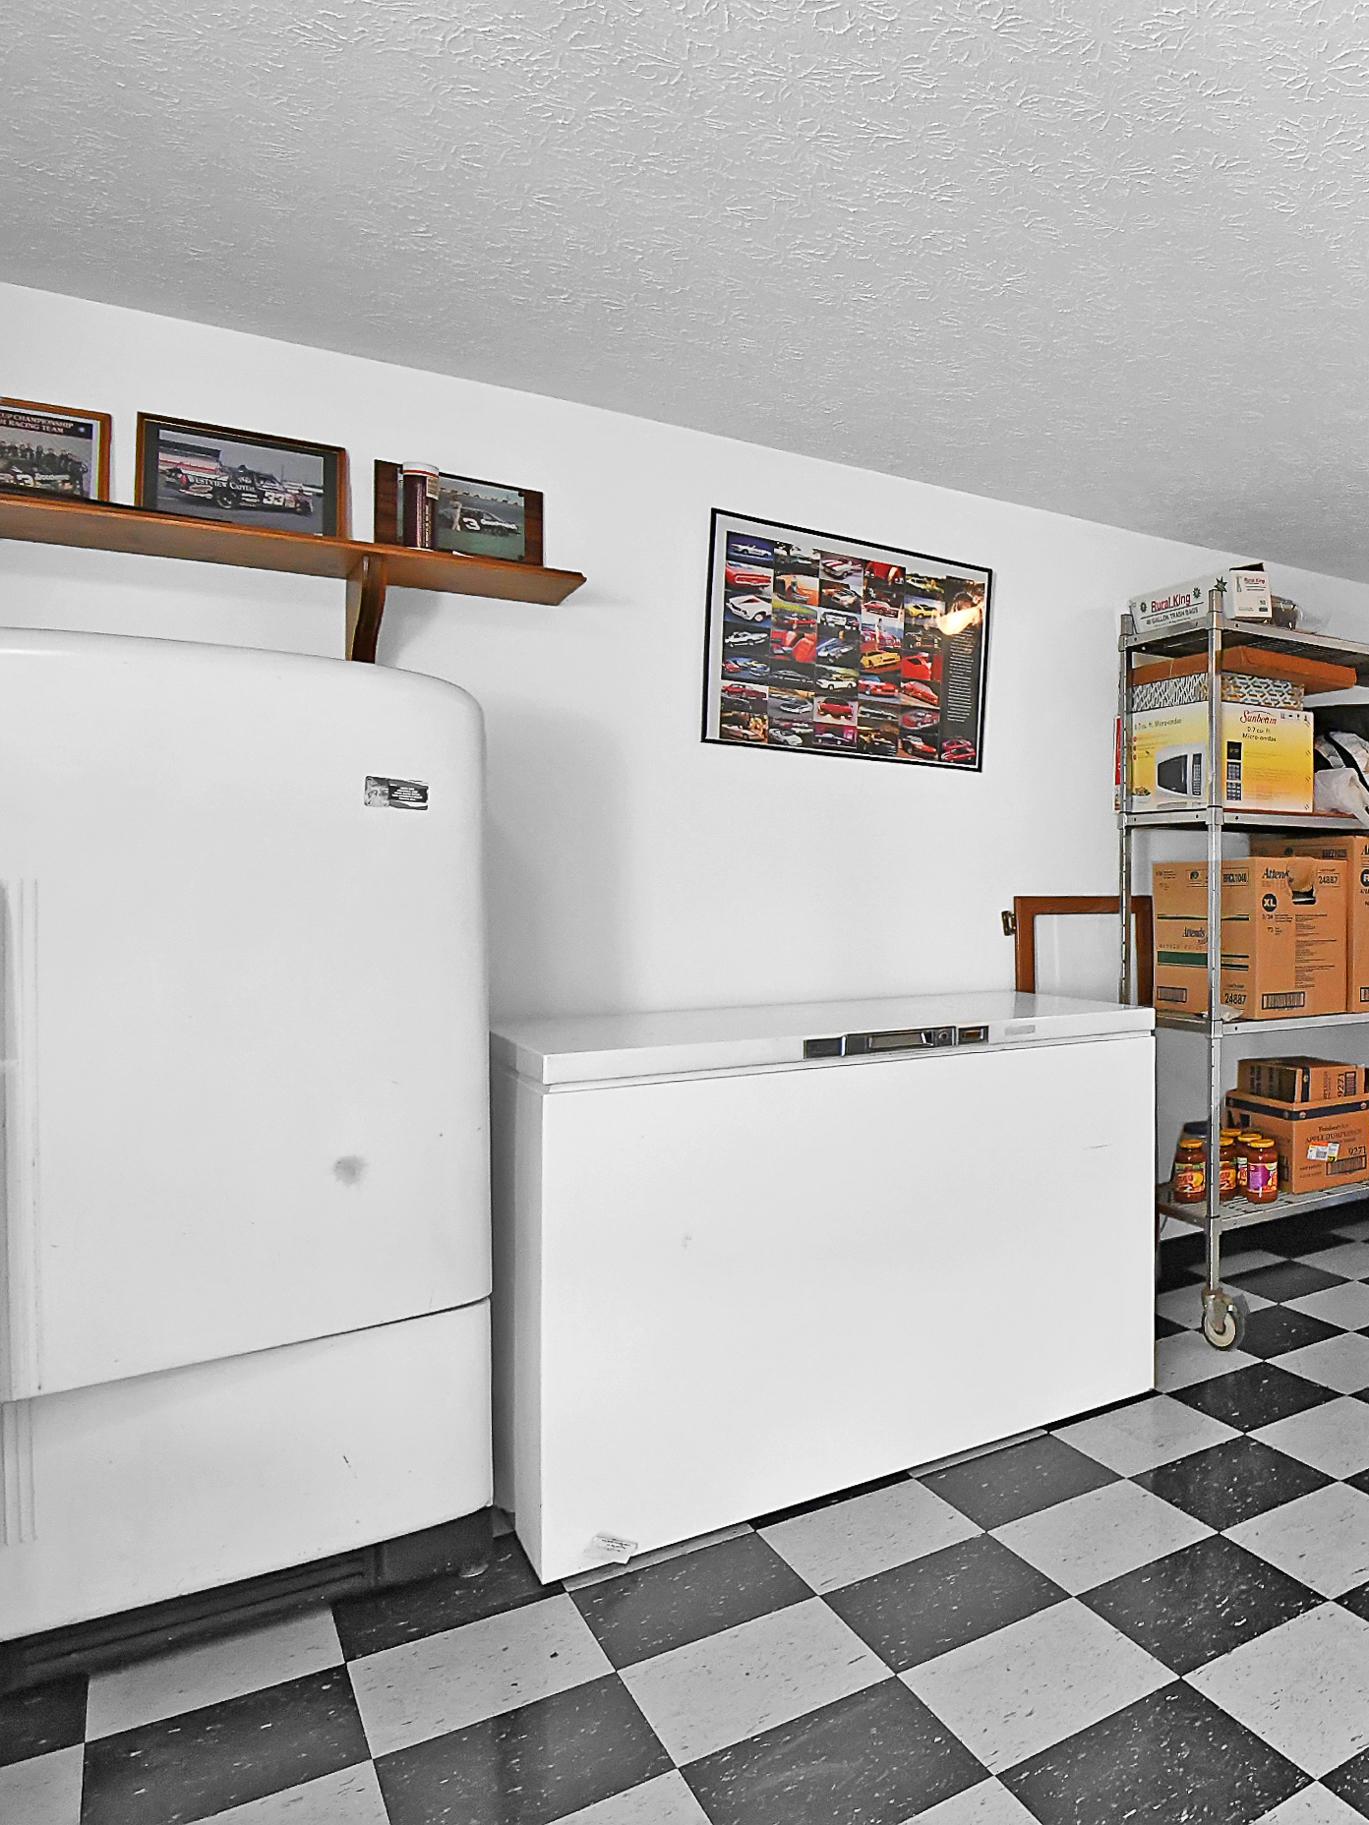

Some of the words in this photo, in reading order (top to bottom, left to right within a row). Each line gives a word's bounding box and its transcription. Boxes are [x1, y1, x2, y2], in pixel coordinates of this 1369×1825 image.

[8, 420, 40, 430] RACING
[42, 425, 64, 434] TEAM
[263, 491, 285, 506] 33
[462, 517, 480, 531] 3
[1151, 598, 1173, 613] Rural
[1173, 593, 1191, 606] King
[1170, 611, 1185, 620] TRASH
[1185, 607, 1199, 616] BAGS
[1239, 709, 1278, 725] Sunbeam
[1262, 898, 1277, 908] XL
[1182, 925, 1206, 938] Attends
[1348, 1145, 1367, 1156] 9271
